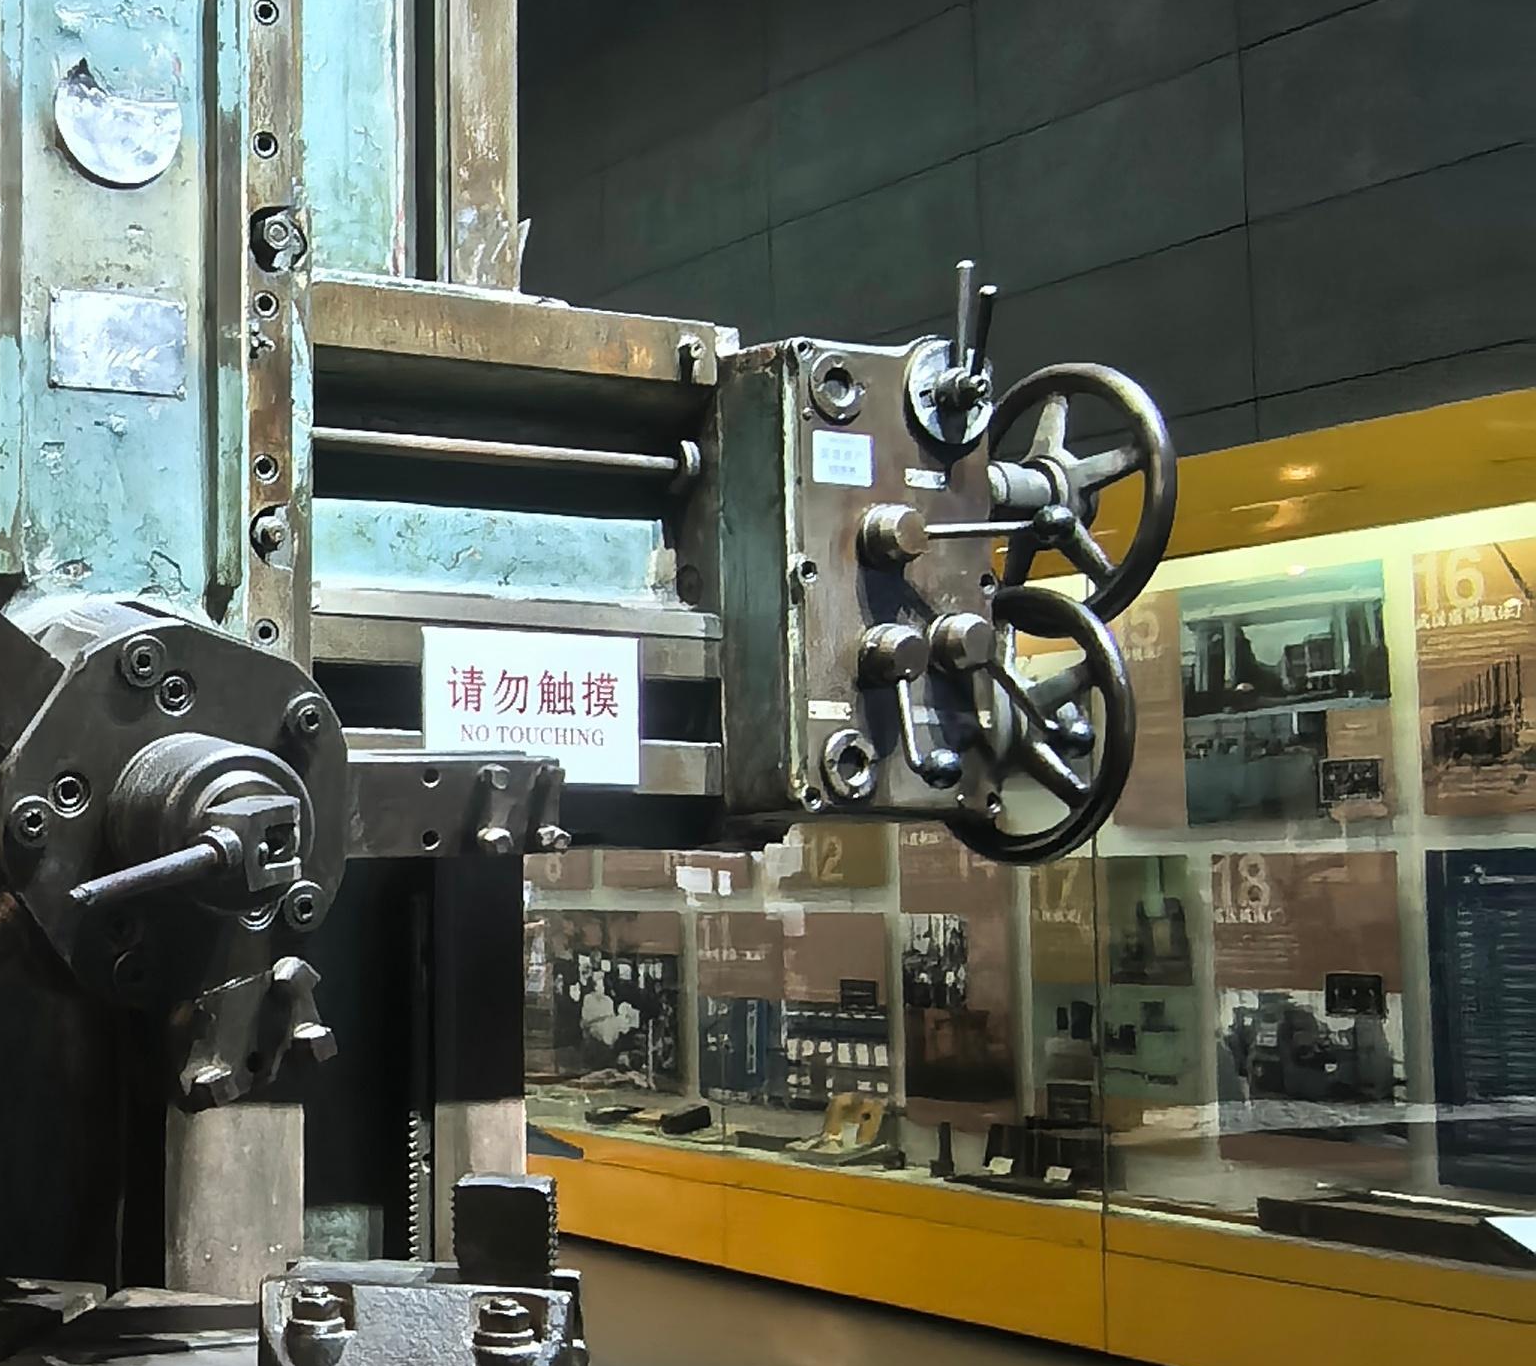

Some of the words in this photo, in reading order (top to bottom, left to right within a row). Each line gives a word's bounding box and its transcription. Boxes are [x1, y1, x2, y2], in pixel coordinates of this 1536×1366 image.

[1415, 550, 1484, 611] 16
[447, 665, 619, 718] 请勿触摸
[460, 724, 490, 743] NO
[496, 725, 605, 747] TOUCHING
[1212, 854, 1270, 910] 18
